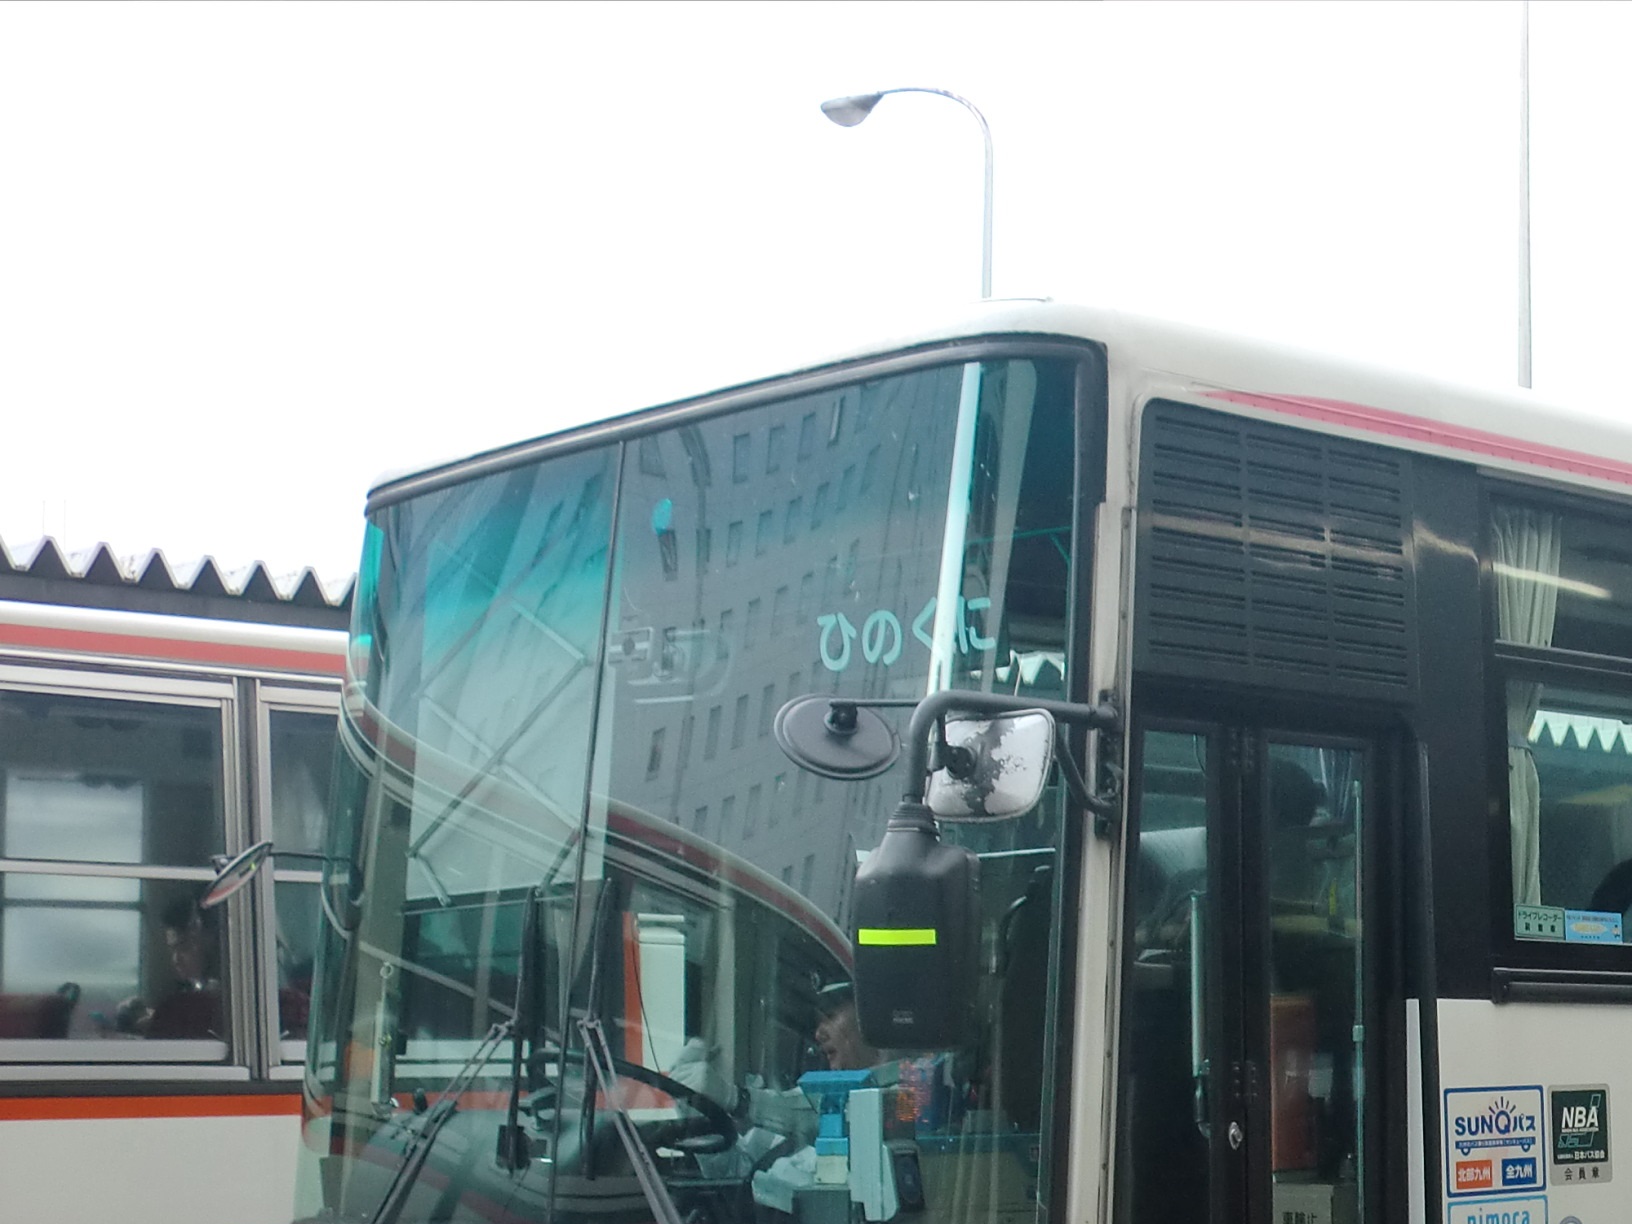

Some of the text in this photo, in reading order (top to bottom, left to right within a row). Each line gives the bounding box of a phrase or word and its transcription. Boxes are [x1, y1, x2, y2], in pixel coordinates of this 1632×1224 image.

[816, 596, 997, 672] ひのくに
[1561, 1106, 1599, 1128] NBA
[1505, 1164, 1534, 1180] 全九州
